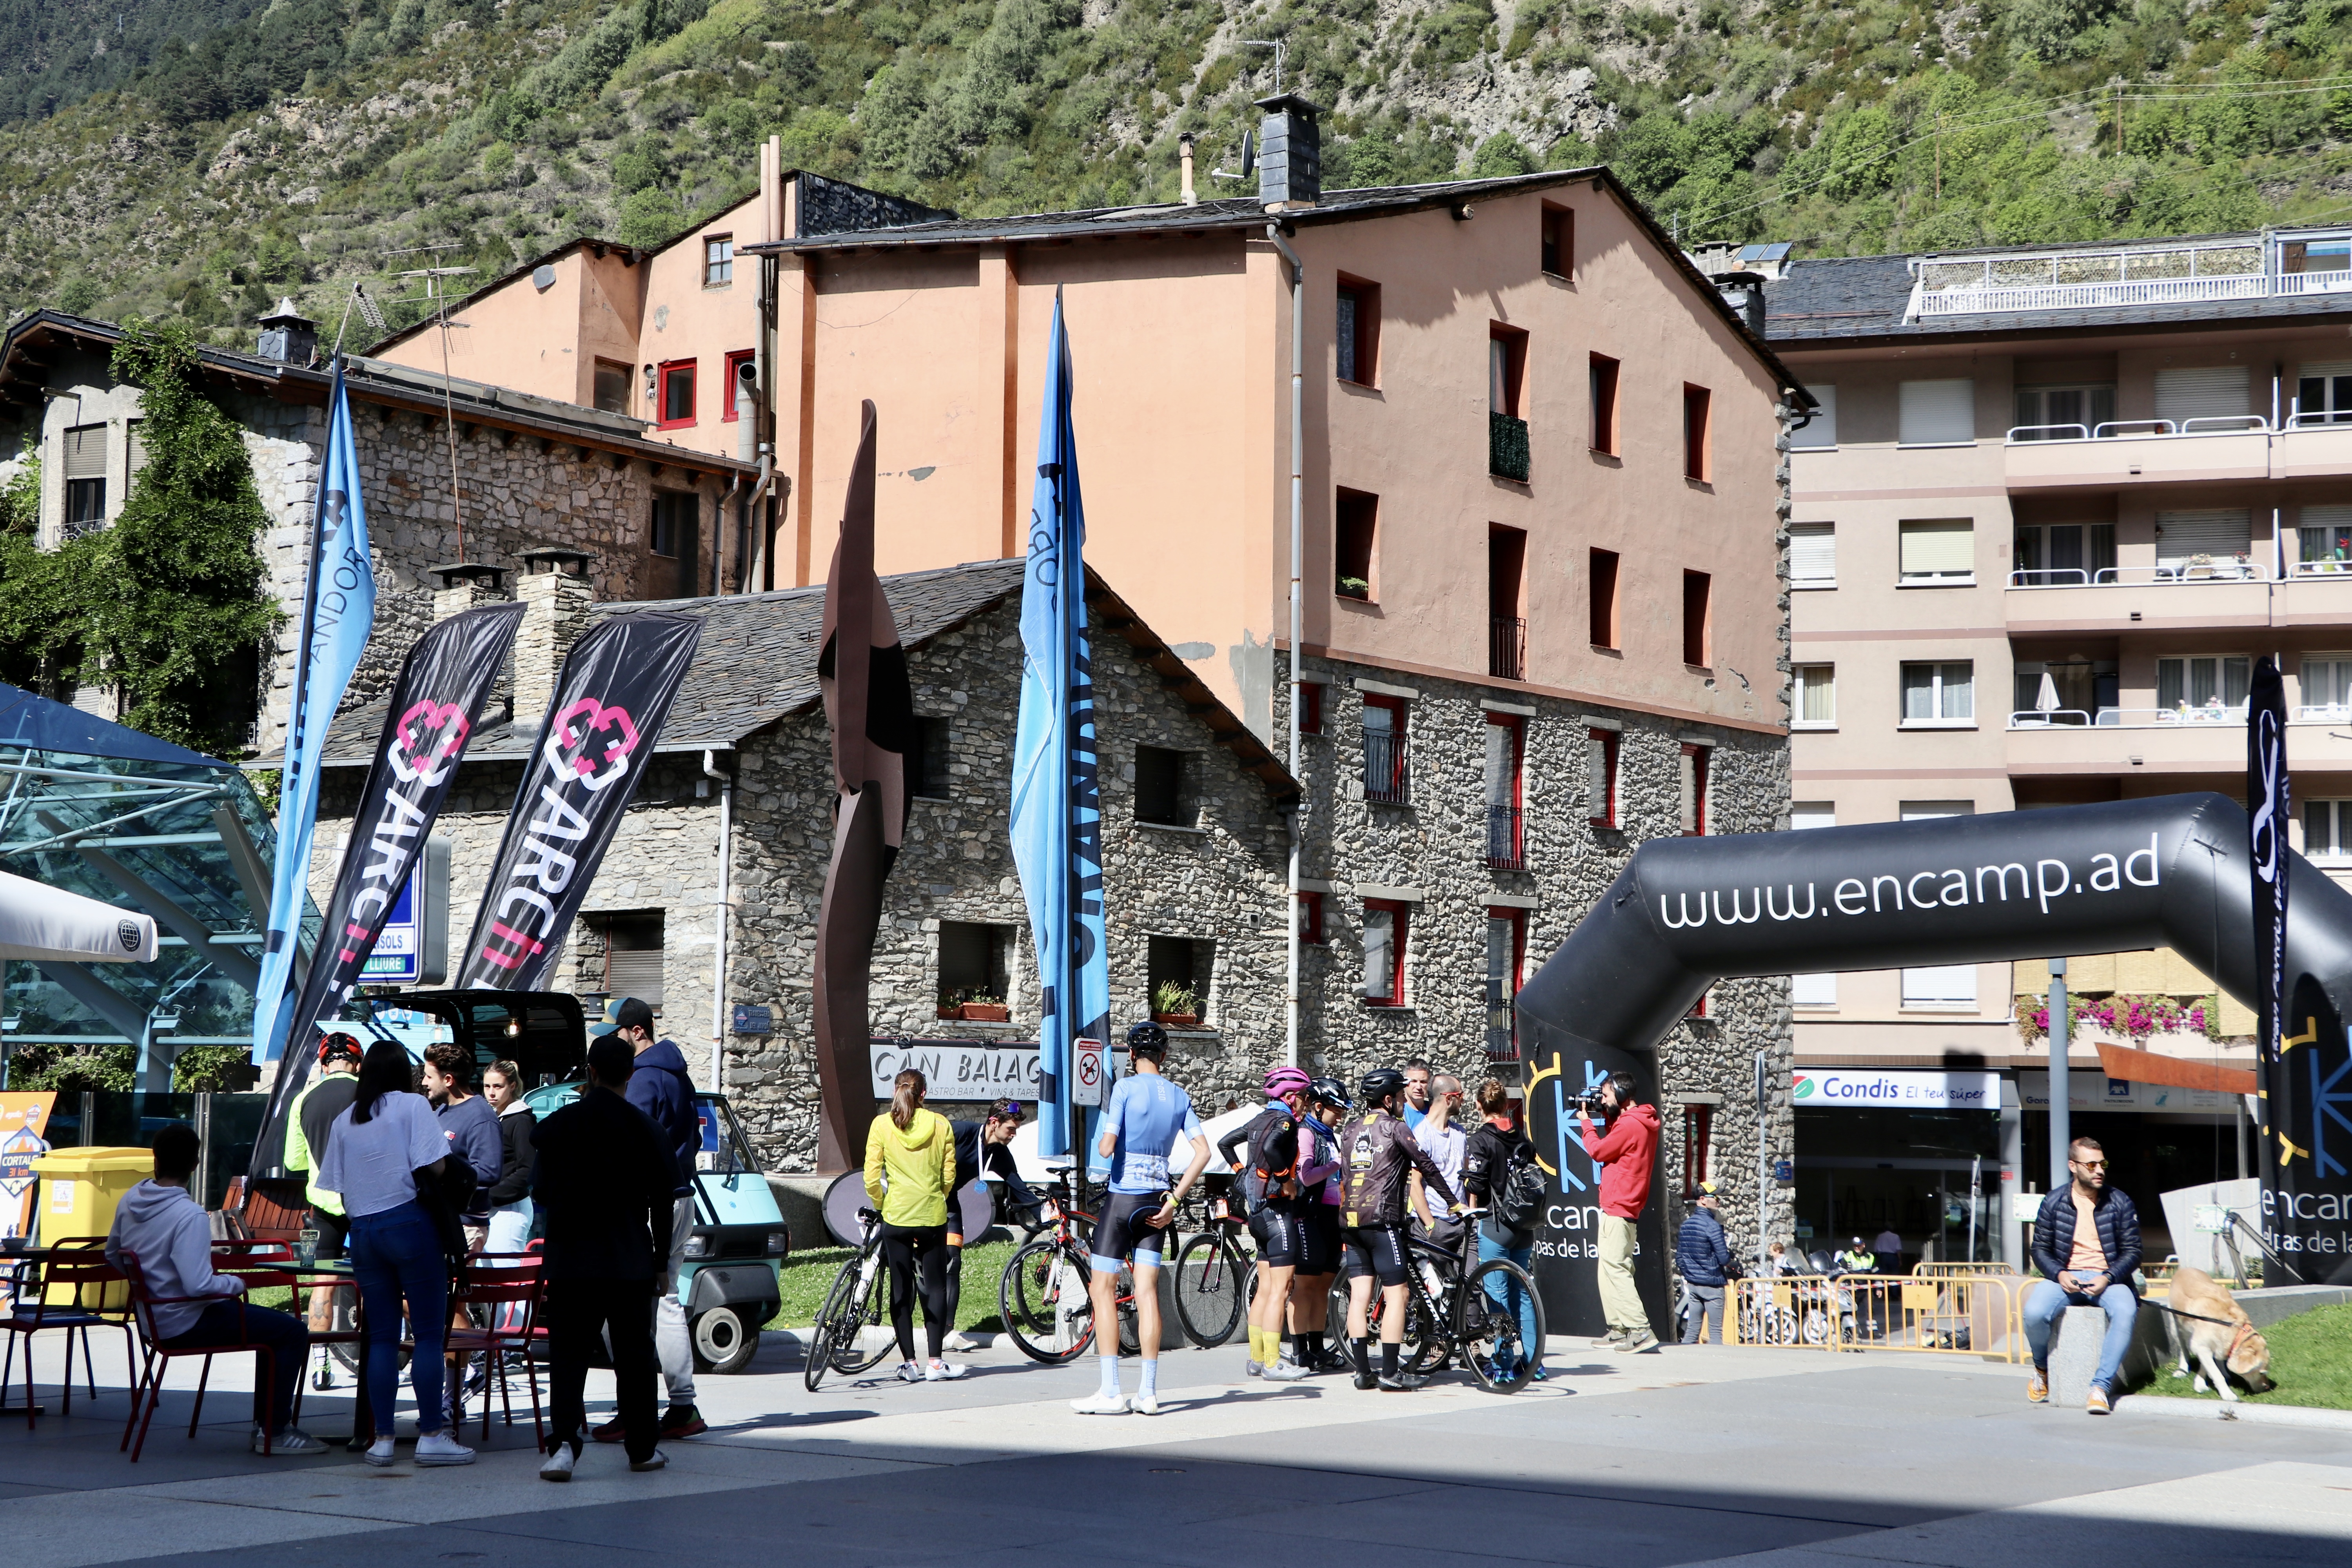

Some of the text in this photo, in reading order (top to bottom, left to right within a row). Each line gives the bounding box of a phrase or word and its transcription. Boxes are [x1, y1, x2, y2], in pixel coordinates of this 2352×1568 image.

[310, 546, 363, 664] ANDOR
[1661, 831, 2159, 929] www.encamp.ad
[369, 956, 401, 971] LLIURE
[875, 1051, 1040, 1084] CAN BALAG
[927, 1087, 955, 1096] ASTRO
[957, 1087, 975, 1096] BAR
[990, 1088, 1007, 1096] VINS
[1017, 1088, 1040, 1097] TAPES
[1157, 1086, 1166, 1101] OTSO
[1824, 1077, 1986, 1101] Condis El teu súper
[2026, 1096, 2049, 1105] Gara
[8, 1168, 29, 1177] 31 km
[1535, 1240, 1555, 1259] pas
[1557, 1238, 1580, 1258] de
[1583, 1238, 1599, 1258] la
[2307, 1230, 2336, 1253] de
